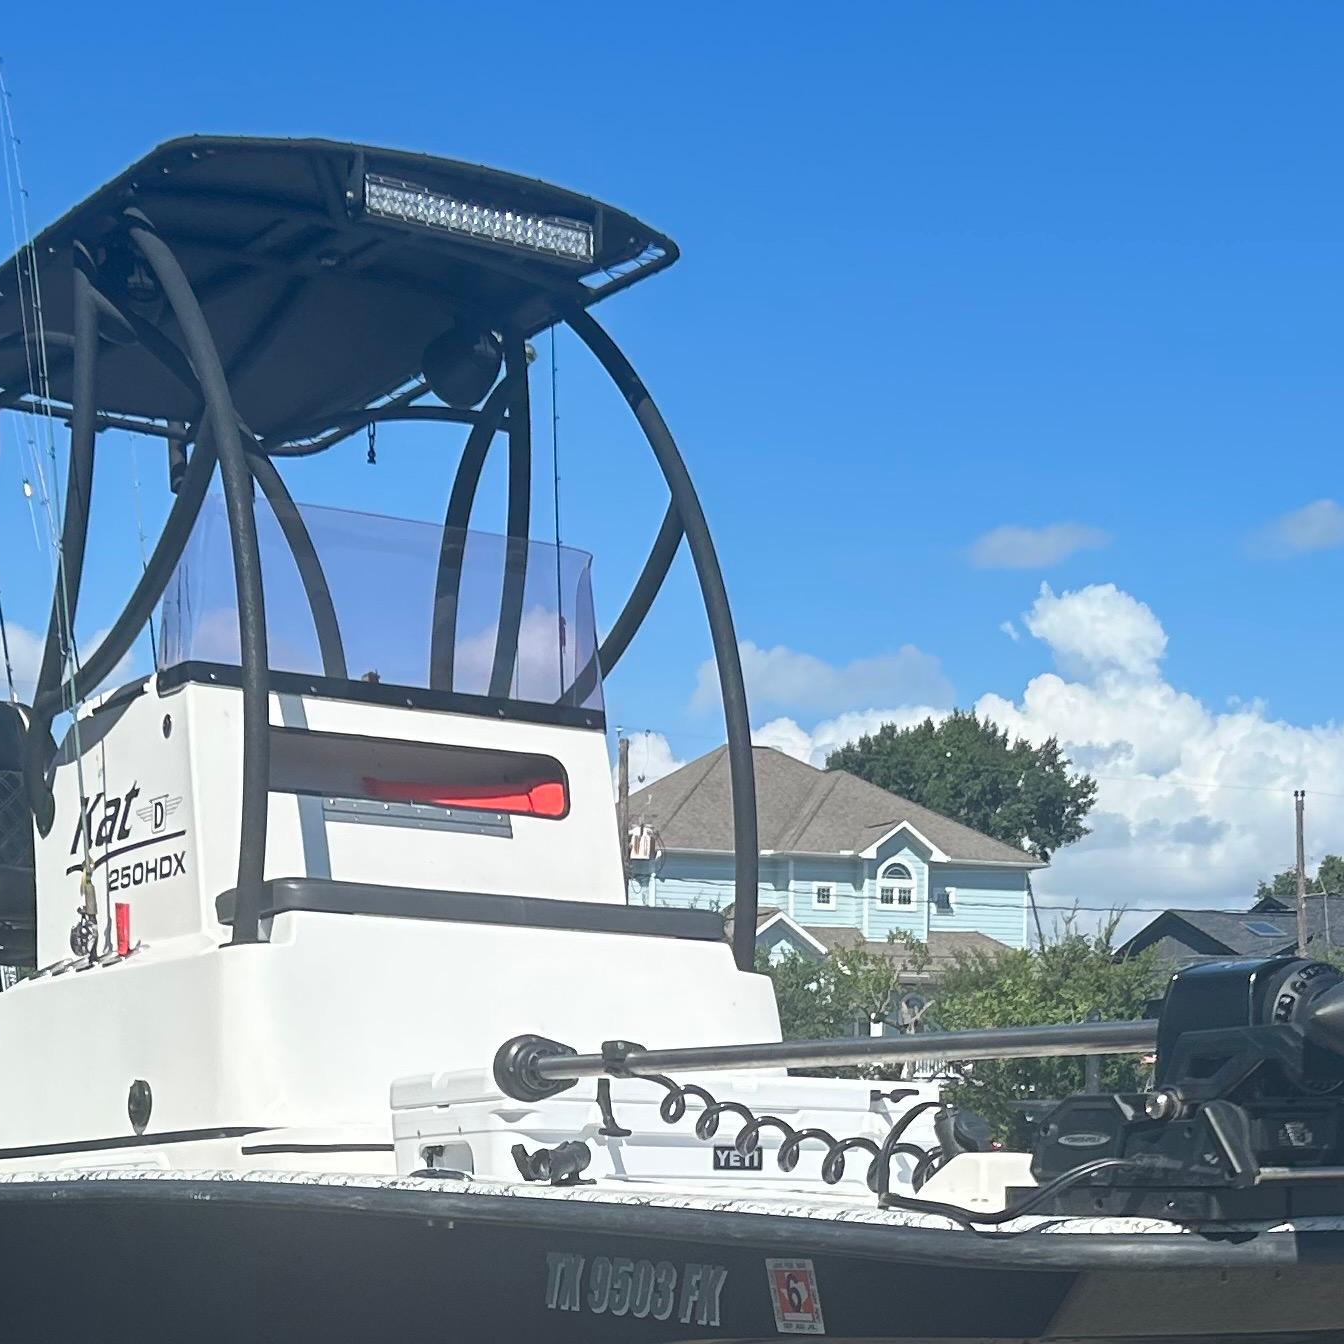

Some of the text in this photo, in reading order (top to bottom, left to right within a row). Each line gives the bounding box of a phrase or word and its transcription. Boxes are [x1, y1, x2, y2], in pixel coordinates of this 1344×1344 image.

[70, 780, 140, 855] Kat
[108, 850, 186, 892] 250HDX
[716, 1150, 759, 1167] YETI
[545, 1252, 586, 1312] TX
[587, 1256, 678, 1321] 9503
[678, 1263, 729, 1327] FK
